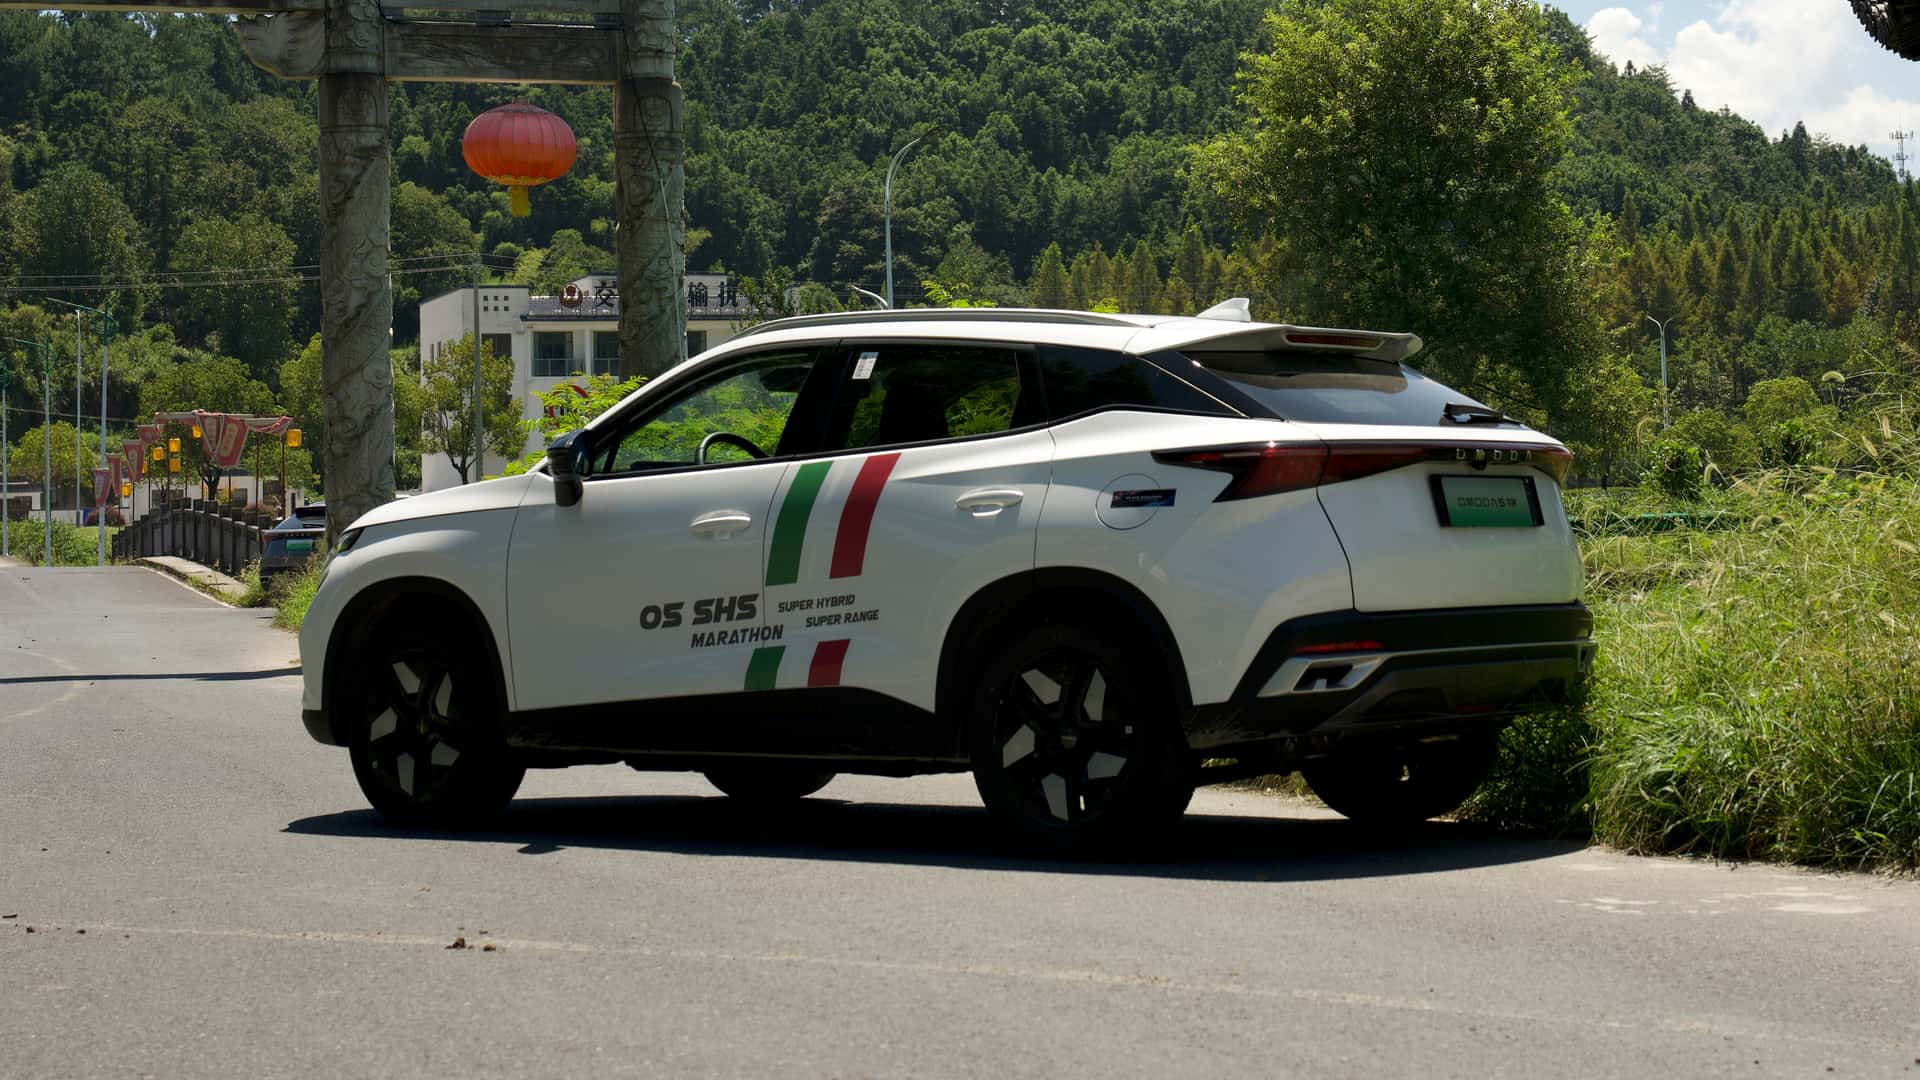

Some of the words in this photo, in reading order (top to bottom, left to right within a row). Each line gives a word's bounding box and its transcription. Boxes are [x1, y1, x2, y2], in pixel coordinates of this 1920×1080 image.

[691, 593, 760, 625] SHS
[777, 599, 814, 613] SUPER
[816, 594, 856, 609] HYBRID
[805, 612, 842, 628] SUPER
[844, 609, 880, 624] RANGE
[691, 625, 784, 649] MARATHON
